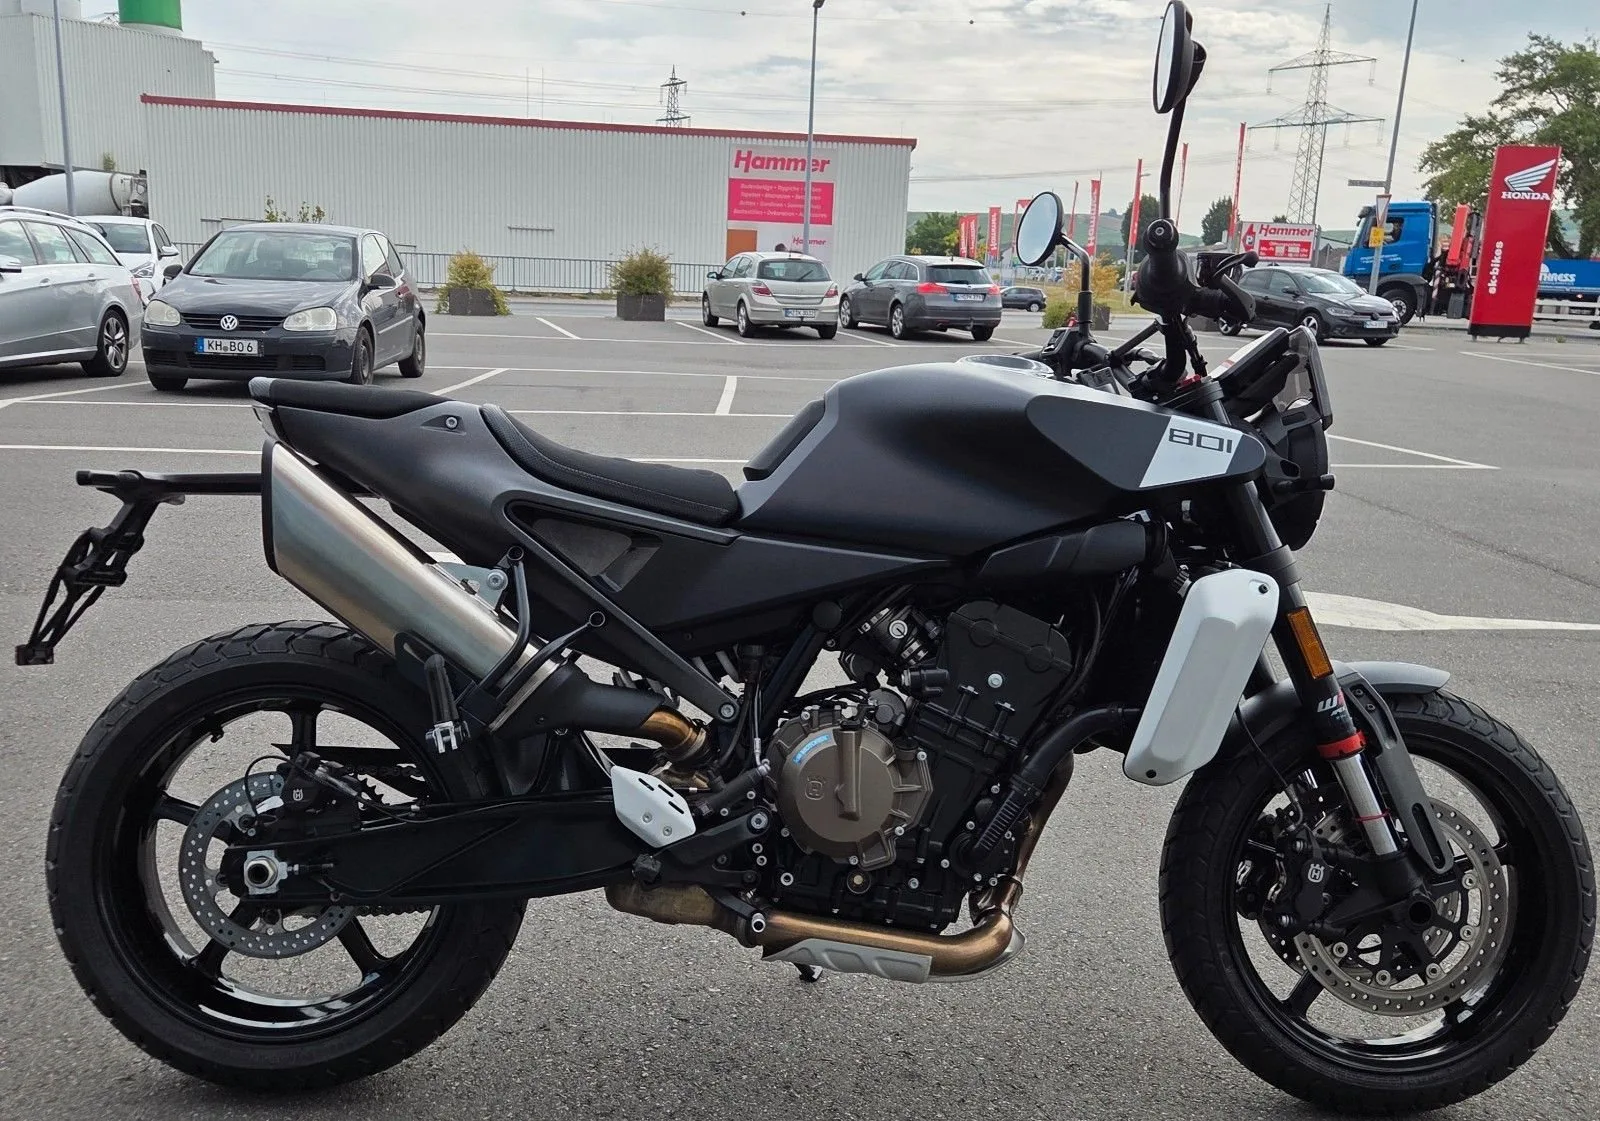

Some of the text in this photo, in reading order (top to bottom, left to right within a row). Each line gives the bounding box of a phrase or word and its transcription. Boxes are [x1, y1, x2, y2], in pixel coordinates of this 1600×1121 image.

[734, 150, 830, 173] Hammer
[1501, 191, 1551, 200] HONDA
[1259, 224, 1313, 236] Hammer
[208, 340, 222, 351] KH
[247, 342, 253, 352] 6
[1169, 428, 1232, 453] 801
